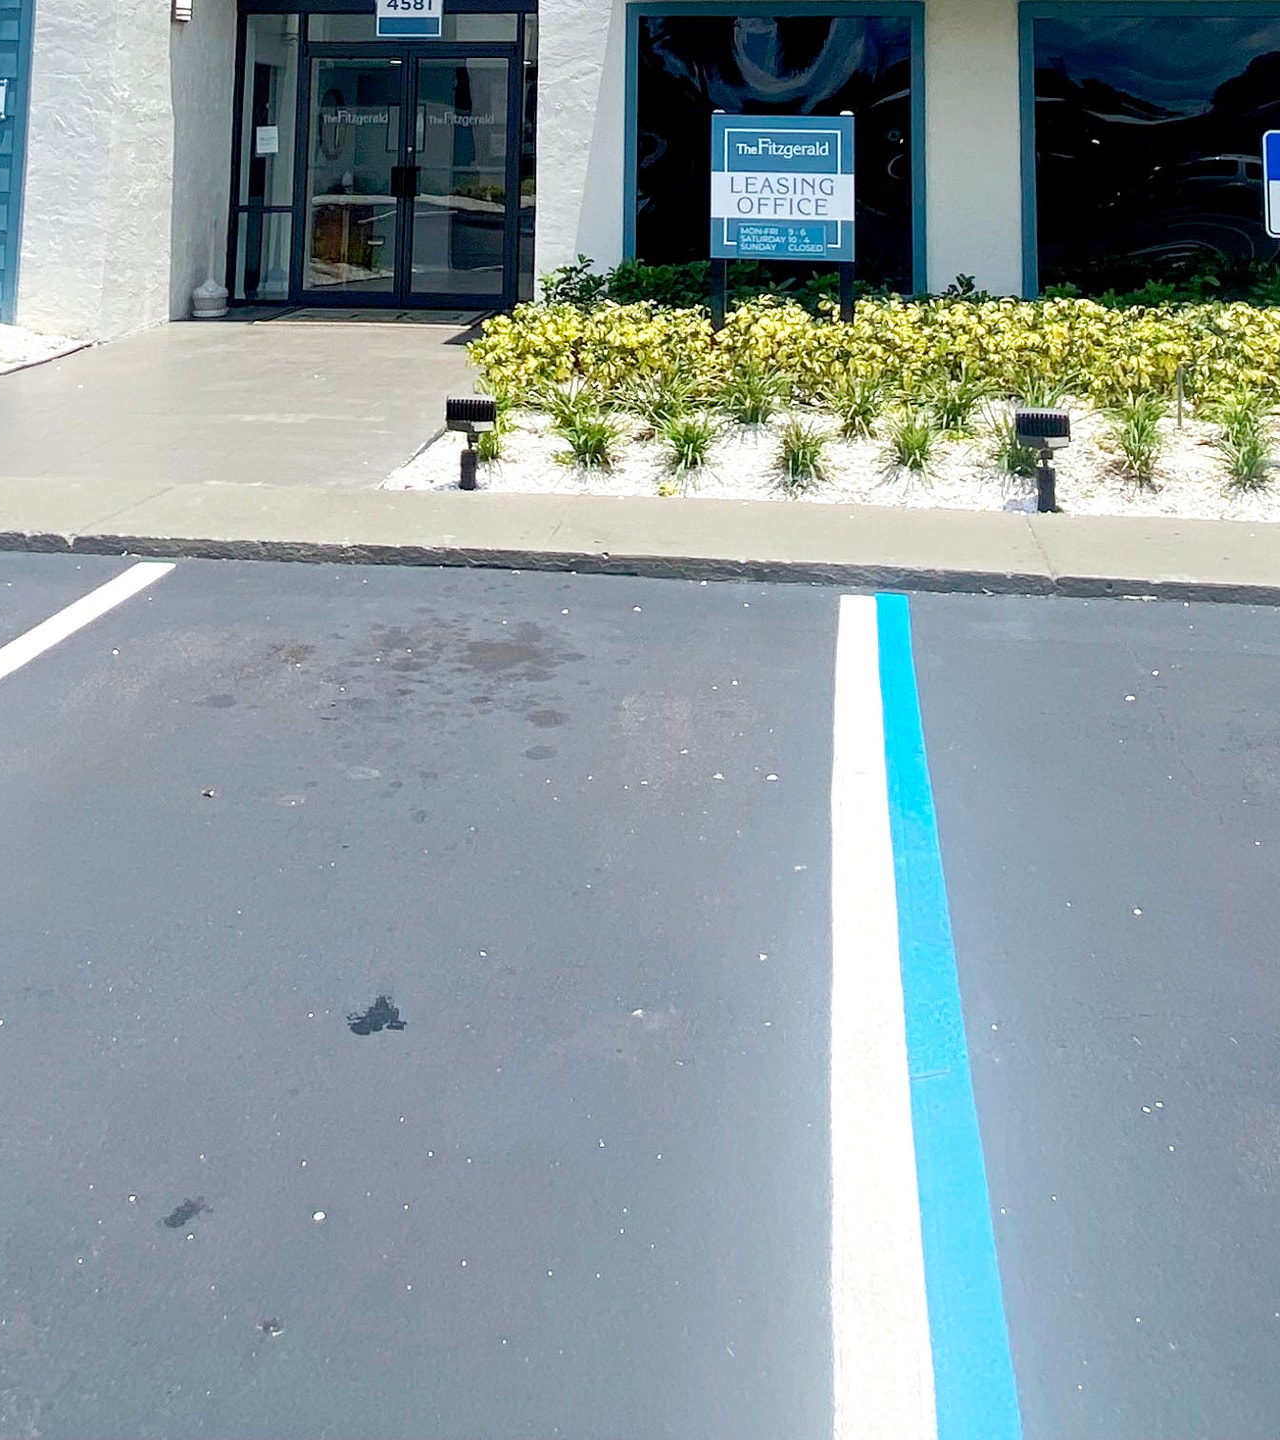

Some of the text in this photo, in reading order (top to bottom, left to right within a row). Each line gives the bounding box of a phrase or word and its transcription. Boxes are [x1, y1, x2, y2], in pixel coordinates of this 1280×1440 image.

[730, 176, 835, 196] LEASING
[736, 197, 829, 216] OFFICE
[740, 227, 779, 235] MON-FRI
[740, 235, 786, 244] SATURDAY
[740, 243, 824, 252] SUNDAY CLOSED
